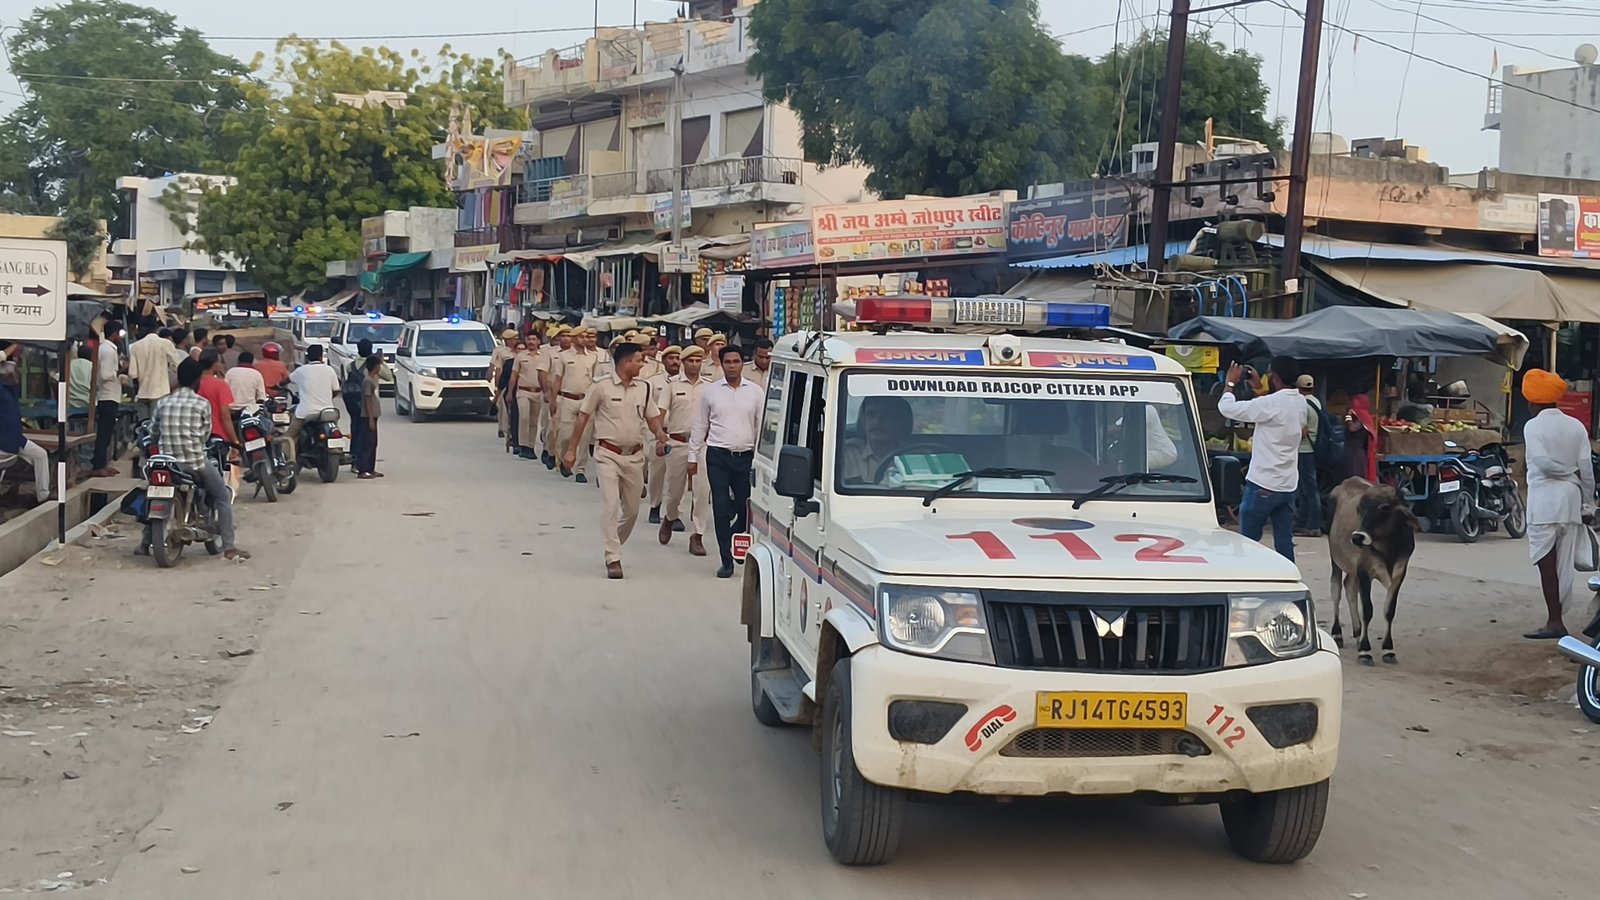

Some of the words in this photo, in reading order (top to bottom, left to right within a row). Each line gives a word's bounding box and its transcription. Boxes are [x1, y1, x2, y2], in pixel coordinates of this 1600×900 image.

[818, 213, 838, 231] श्री
[841, 215, 869, 229] जय
[25, 261, 48, 275] BEAS
[13, 304, 42, 316] व्यास
[888, 379, 978, 392] DOWNLOAD
[982, 381, 1042, 394] RAJCOP
[1046, 383, 1106, 396] CITIZEN
[1109, 385, 1140, 397] APP
[945, 530, 1209, 563] 112
[1051, 698, 1184, 721] RJ14TG4593
[981, 718, 1004, 739] DIAL
[1206, 704, 1246, 749] 112
